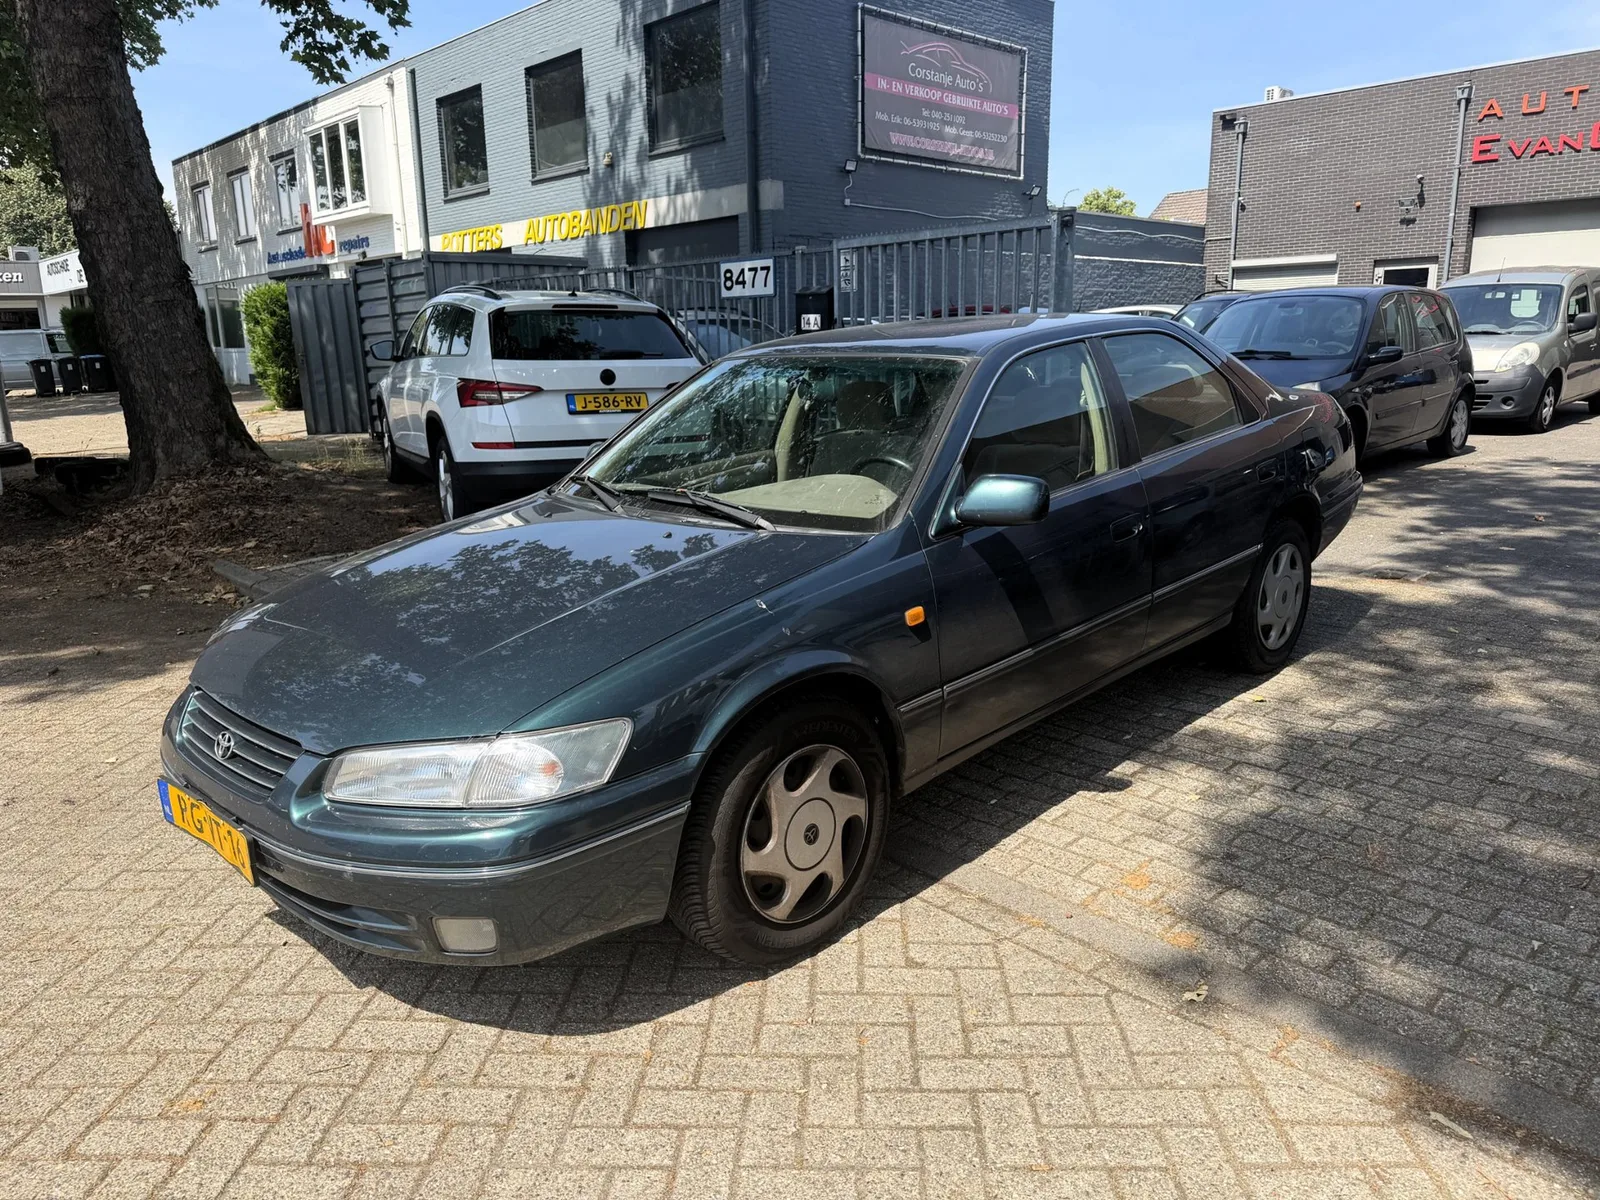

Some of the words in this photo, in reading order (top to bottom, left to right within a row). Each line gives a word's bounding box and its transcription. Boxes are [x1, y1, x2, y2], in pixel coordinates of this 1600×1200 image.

[908, 62, 953, 90] Corstanje
[954, 73, 984, 93] Auto's
[877, 77, 890, 89] IN-
[892, 81, 903, 93] EN
[904, 83, 942, 101] VERKOOP
[943, 91, 982, 110] GEBRUIKTE
[982, 98, 1009, 115] AUTO'S
[441, 223, 503, 252] POTTERS
[523, 199, 648, 246] AUTOBANDEN
[339, 234, 370, 254] repairs
[0, 271, 24, 282] en
[723, 266, 771, 291] 8477
[802, 316, 811, 328] 14
[813, 316, 820, 328] A
[581, 396, 642, 410] J-586-RV
